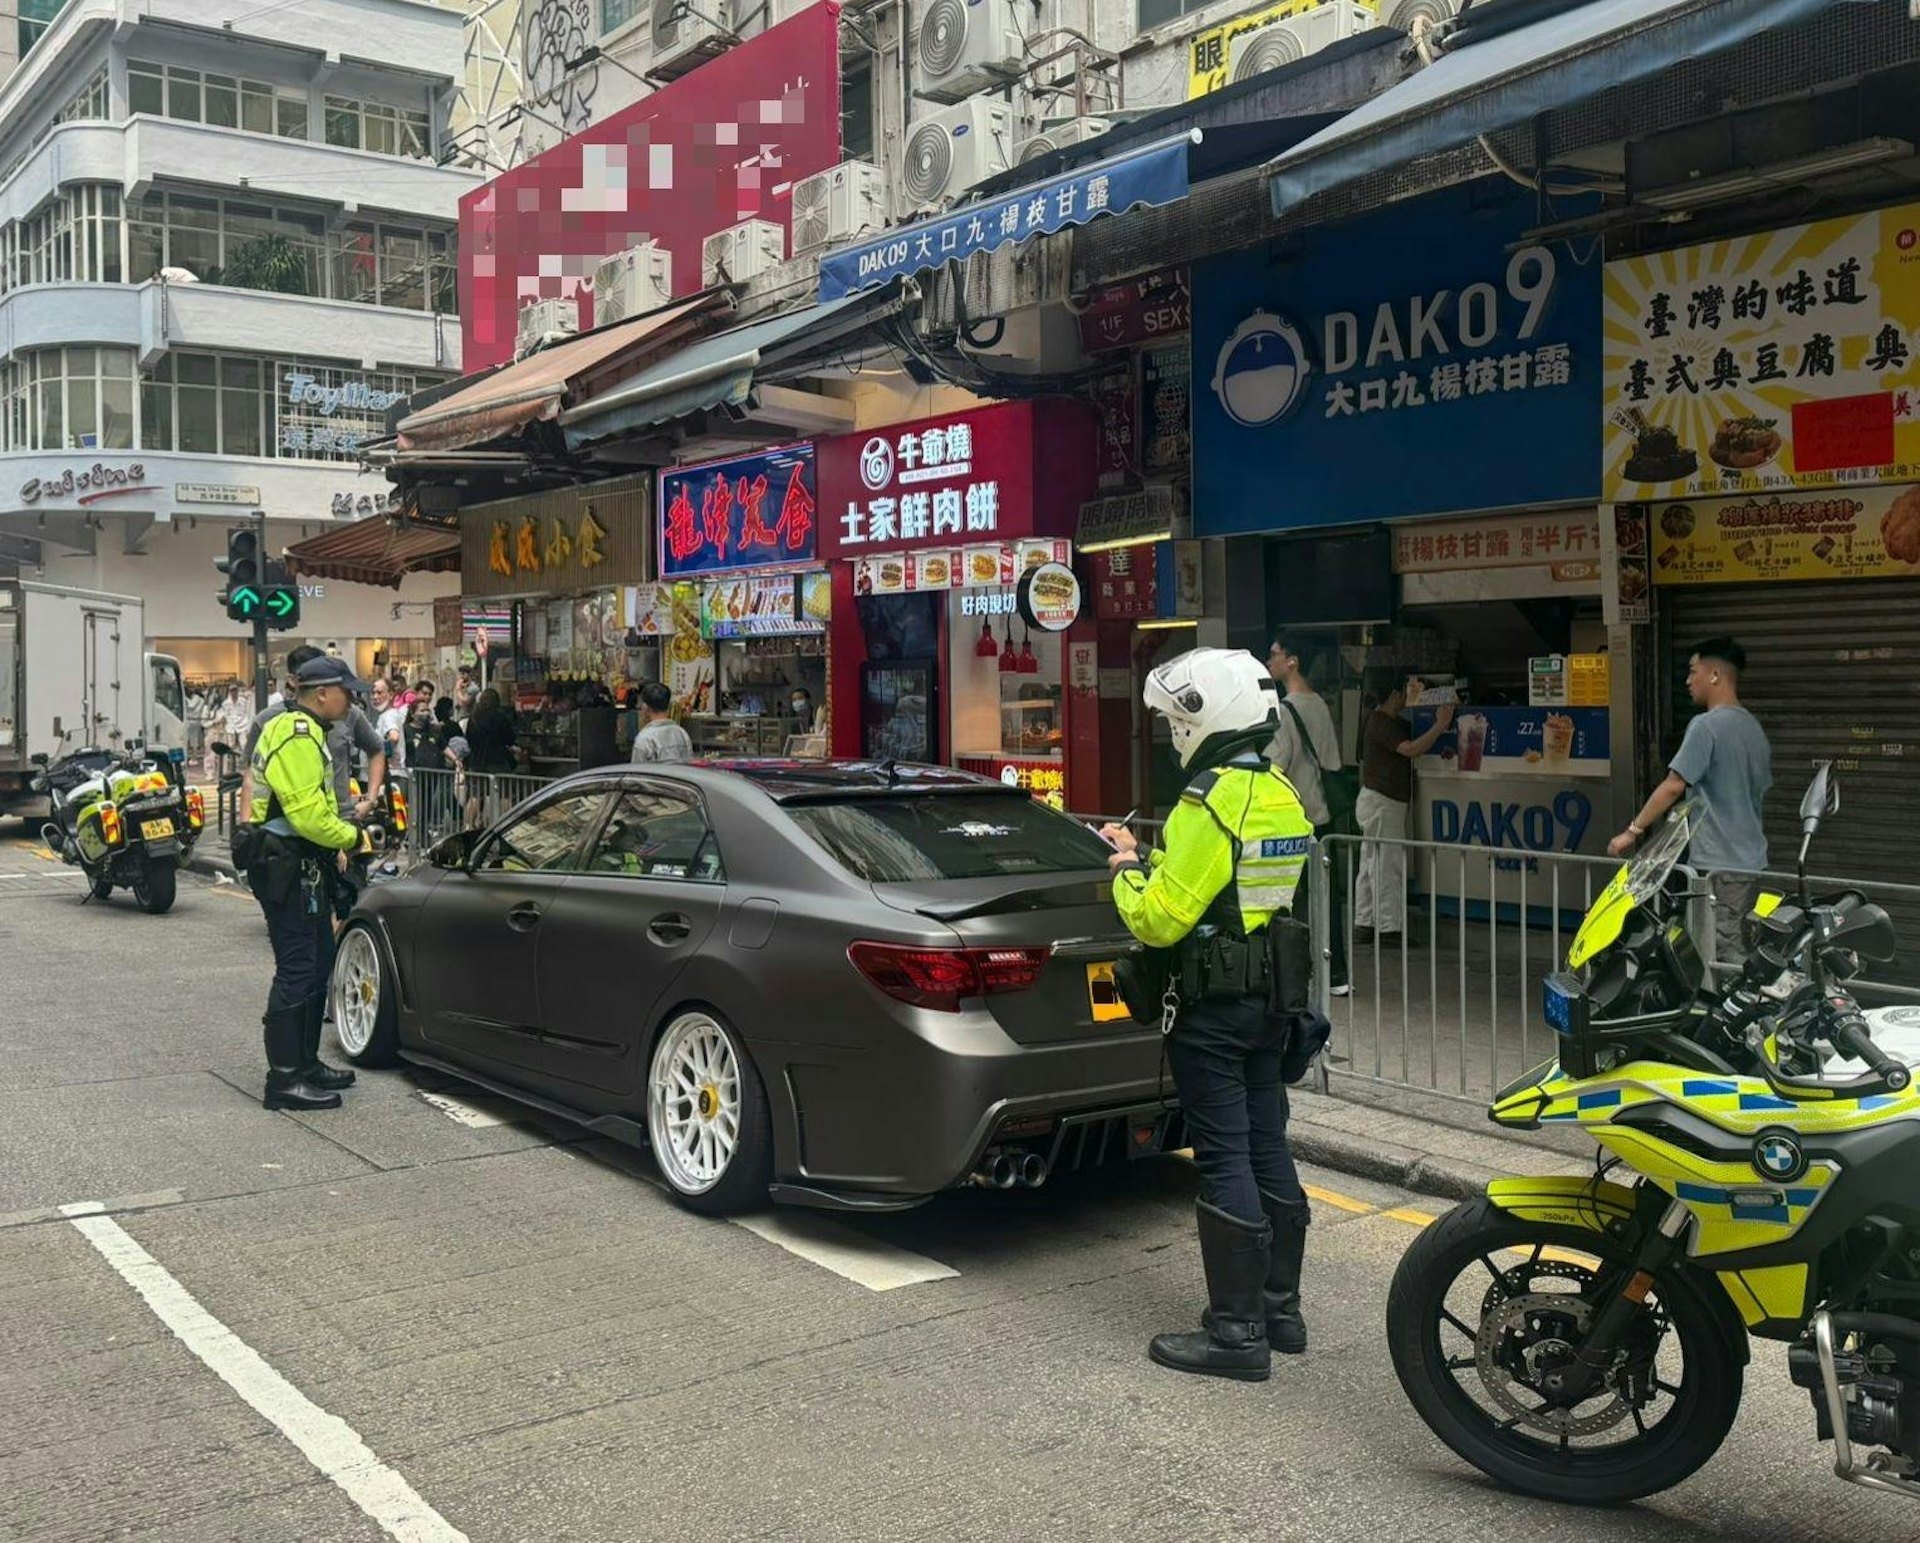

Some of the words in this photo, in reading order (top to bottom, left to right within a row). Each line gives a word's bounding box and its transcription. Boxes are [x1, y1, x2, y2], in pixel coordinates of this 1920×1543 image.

[858, 241, 908, 279] DAKO9
[1324, 246, 1557, 375] DAKO9
[1644, 256, 1869, 340] 臺灣的味道
[1324, 379, 1426, 419] 大口九
[1430, 342, 1572, 402] 楊枝甘露
[19, 463, 146, 503] Cuisine
[840, 481, 999, 545] 土家鮮肉餅
[961, 594, 1018, 617] 好肉現切
[1431, 789, 1591, 853] DAKO9
